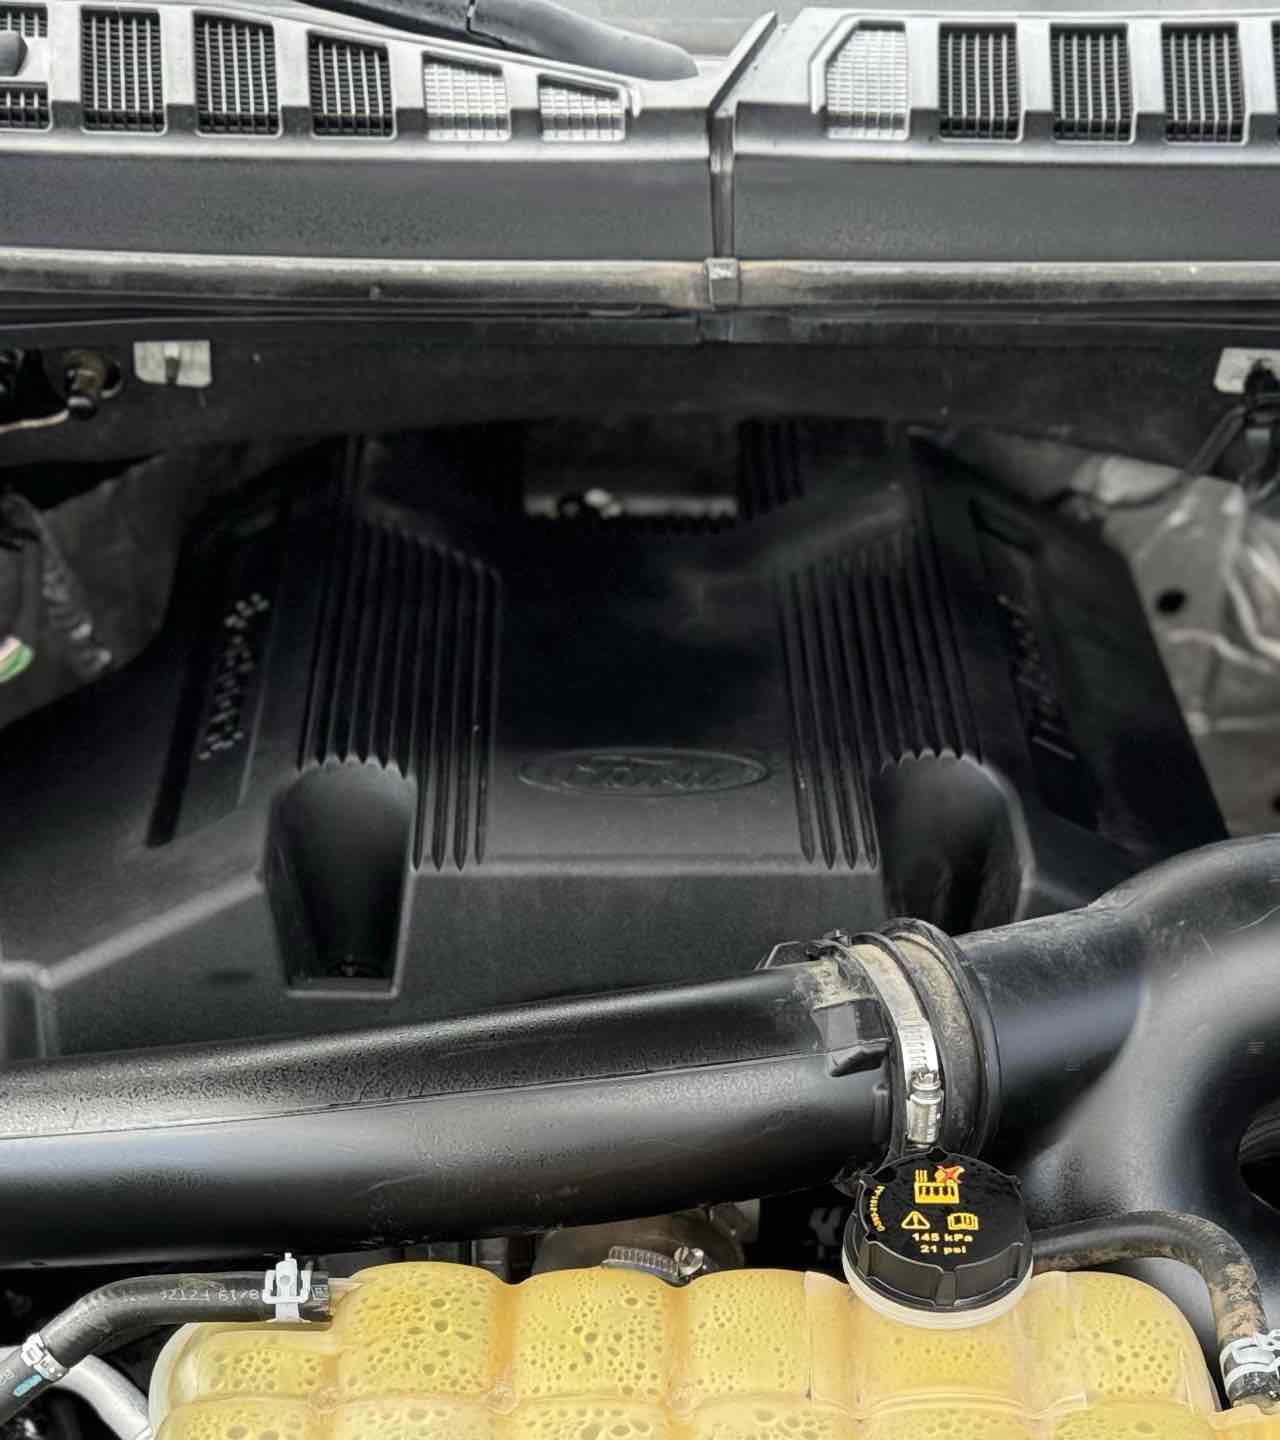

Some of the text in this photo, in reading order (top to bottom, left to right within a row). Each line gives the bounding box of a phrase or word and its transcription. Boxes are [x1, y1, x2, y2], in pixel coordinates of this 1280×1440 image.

[911, 1232, 973, 1242] 145 kPa
[919, 1245, 966, 1255] 21 psi
